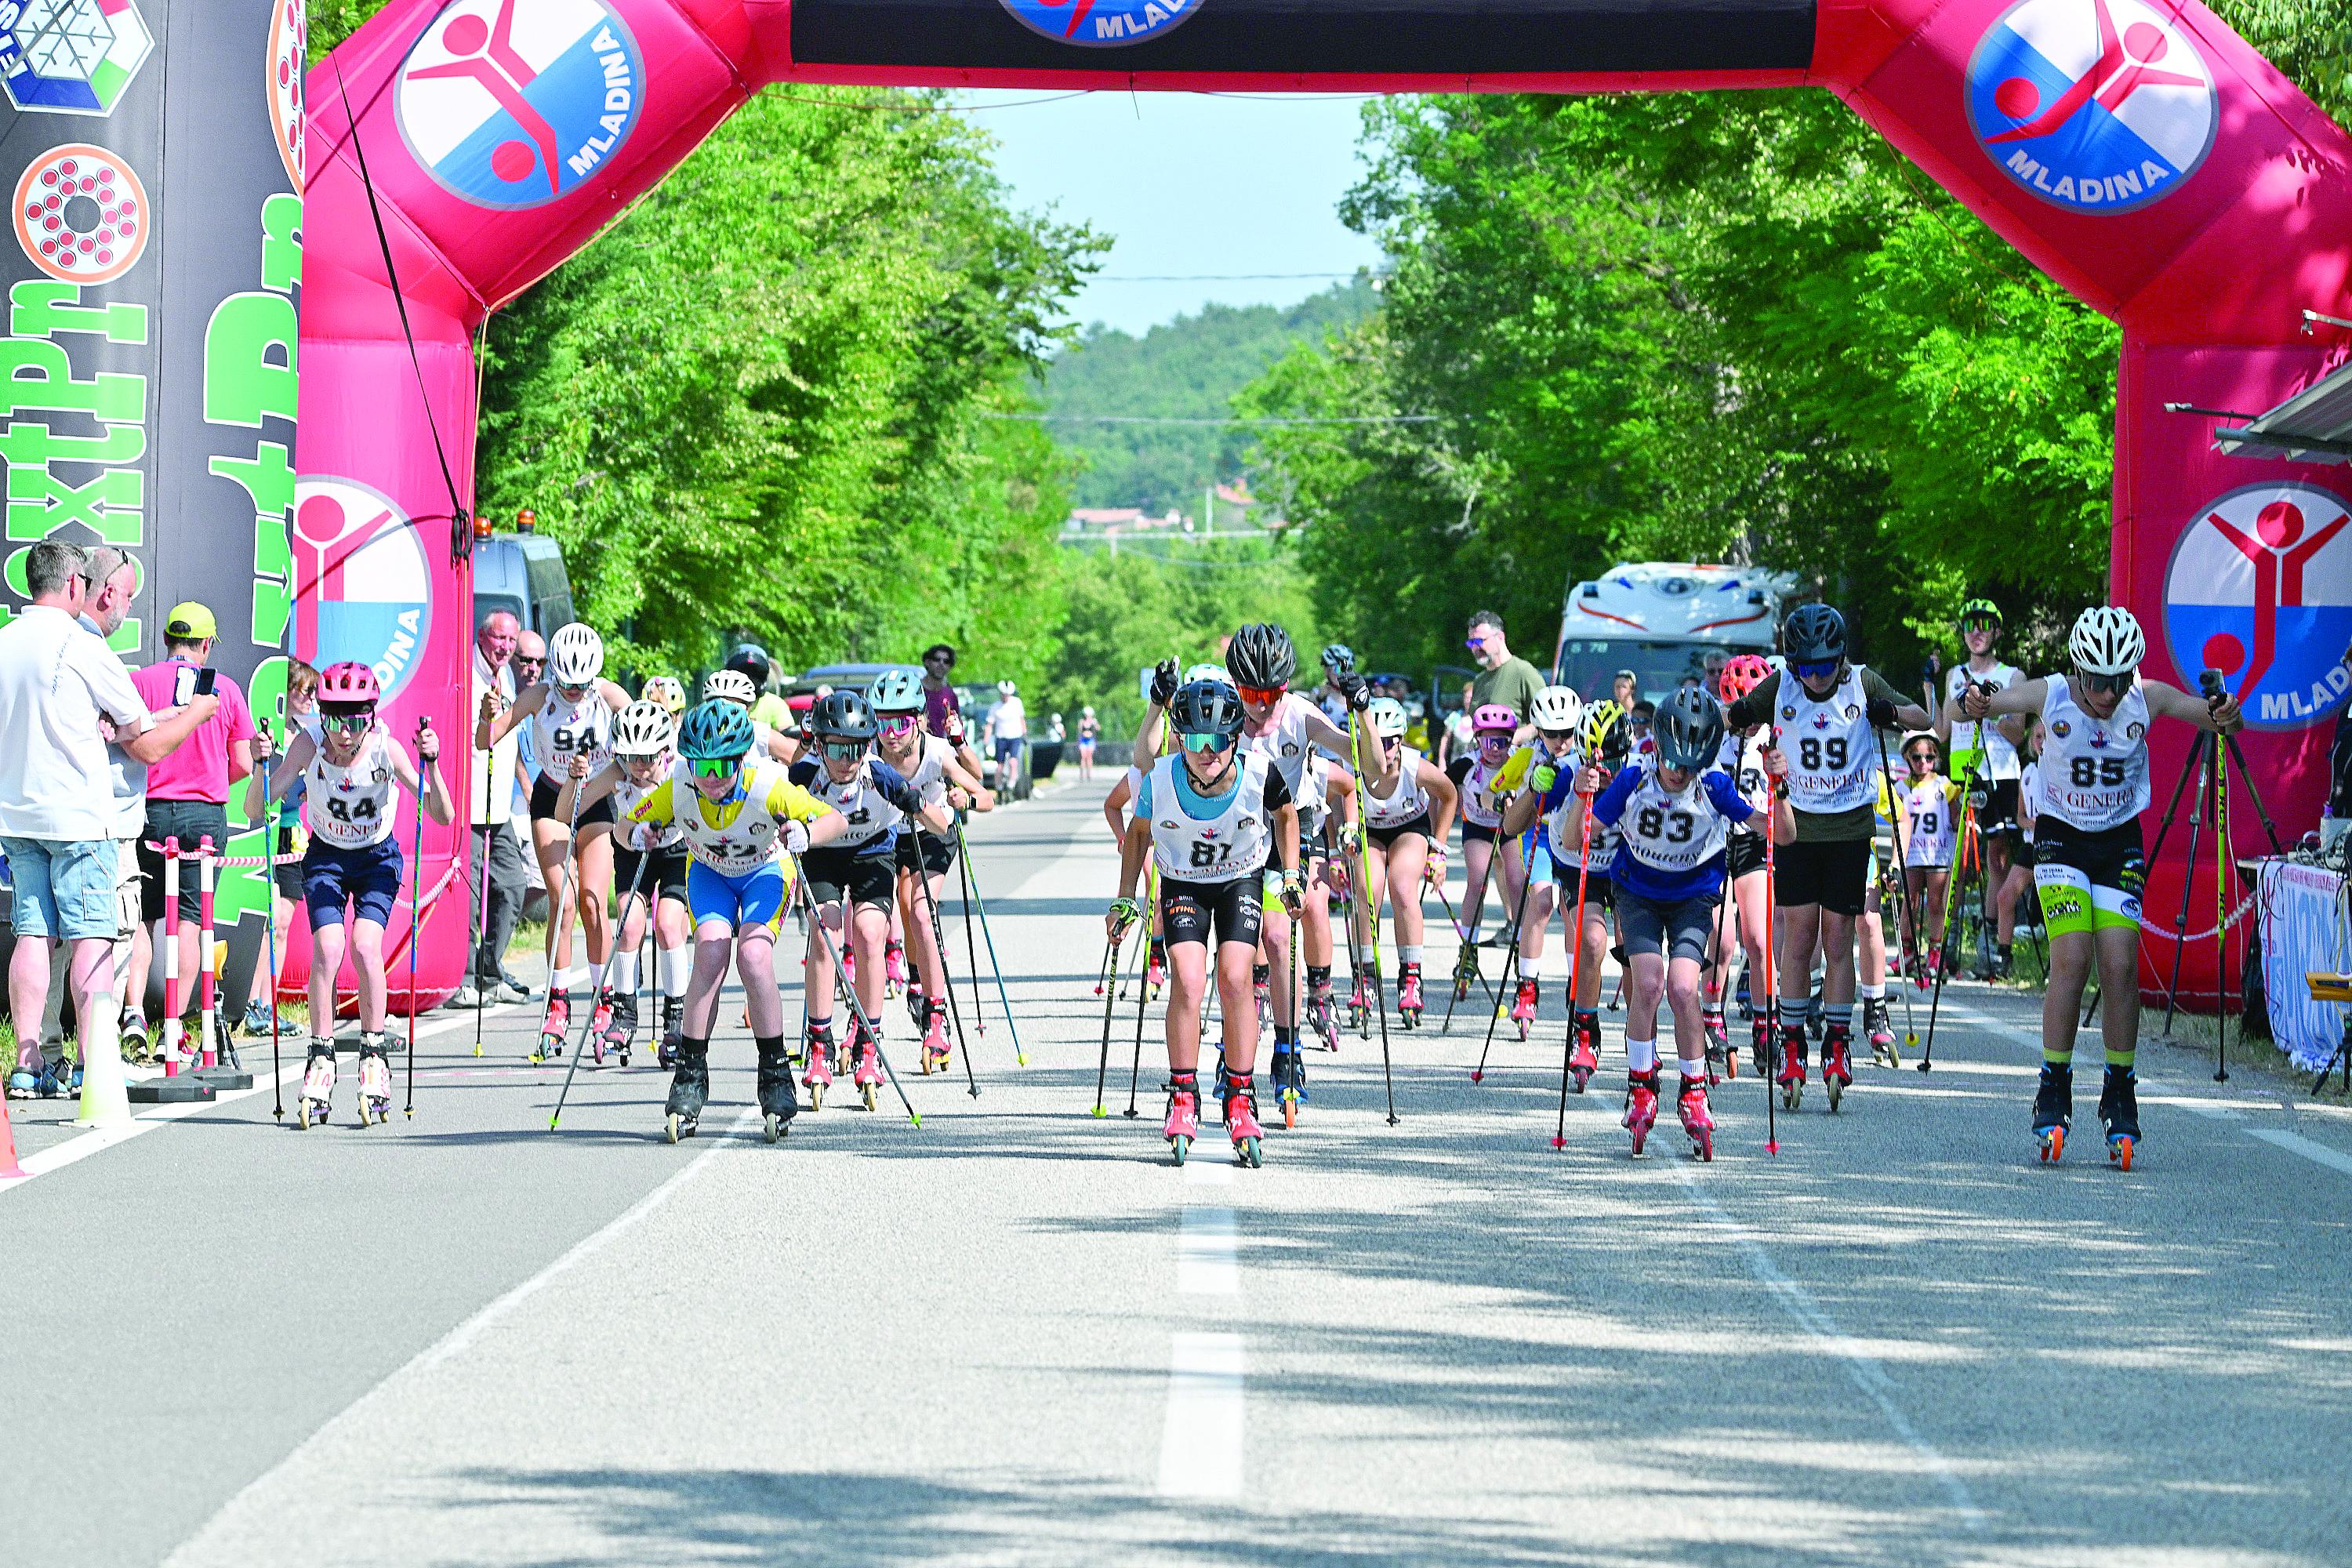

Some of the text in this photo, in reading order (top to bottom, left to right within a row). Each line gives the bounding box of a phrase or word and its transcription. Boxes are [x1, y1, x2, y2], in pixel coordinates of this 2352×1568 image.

[1095, 0, 1186, 38] MLAD
[567, 24, 631, 176] MLADINA
[2006, 149, 2170, 204] MLADINA
[372, 608, 421, 691] DINA
[2261, 666, 2350, 720] MLAD
[554, 727, 598, 751] 94
[1800, 729, 1849, 771] 89
[2070, 755, 2126, 787] 85
[326, 796, 378, 822] 84
[2067, 786, 2136, 810] GENERA
[1637, 807, 1694, 843] 83
[1910, 813, 1938, 834] 79
